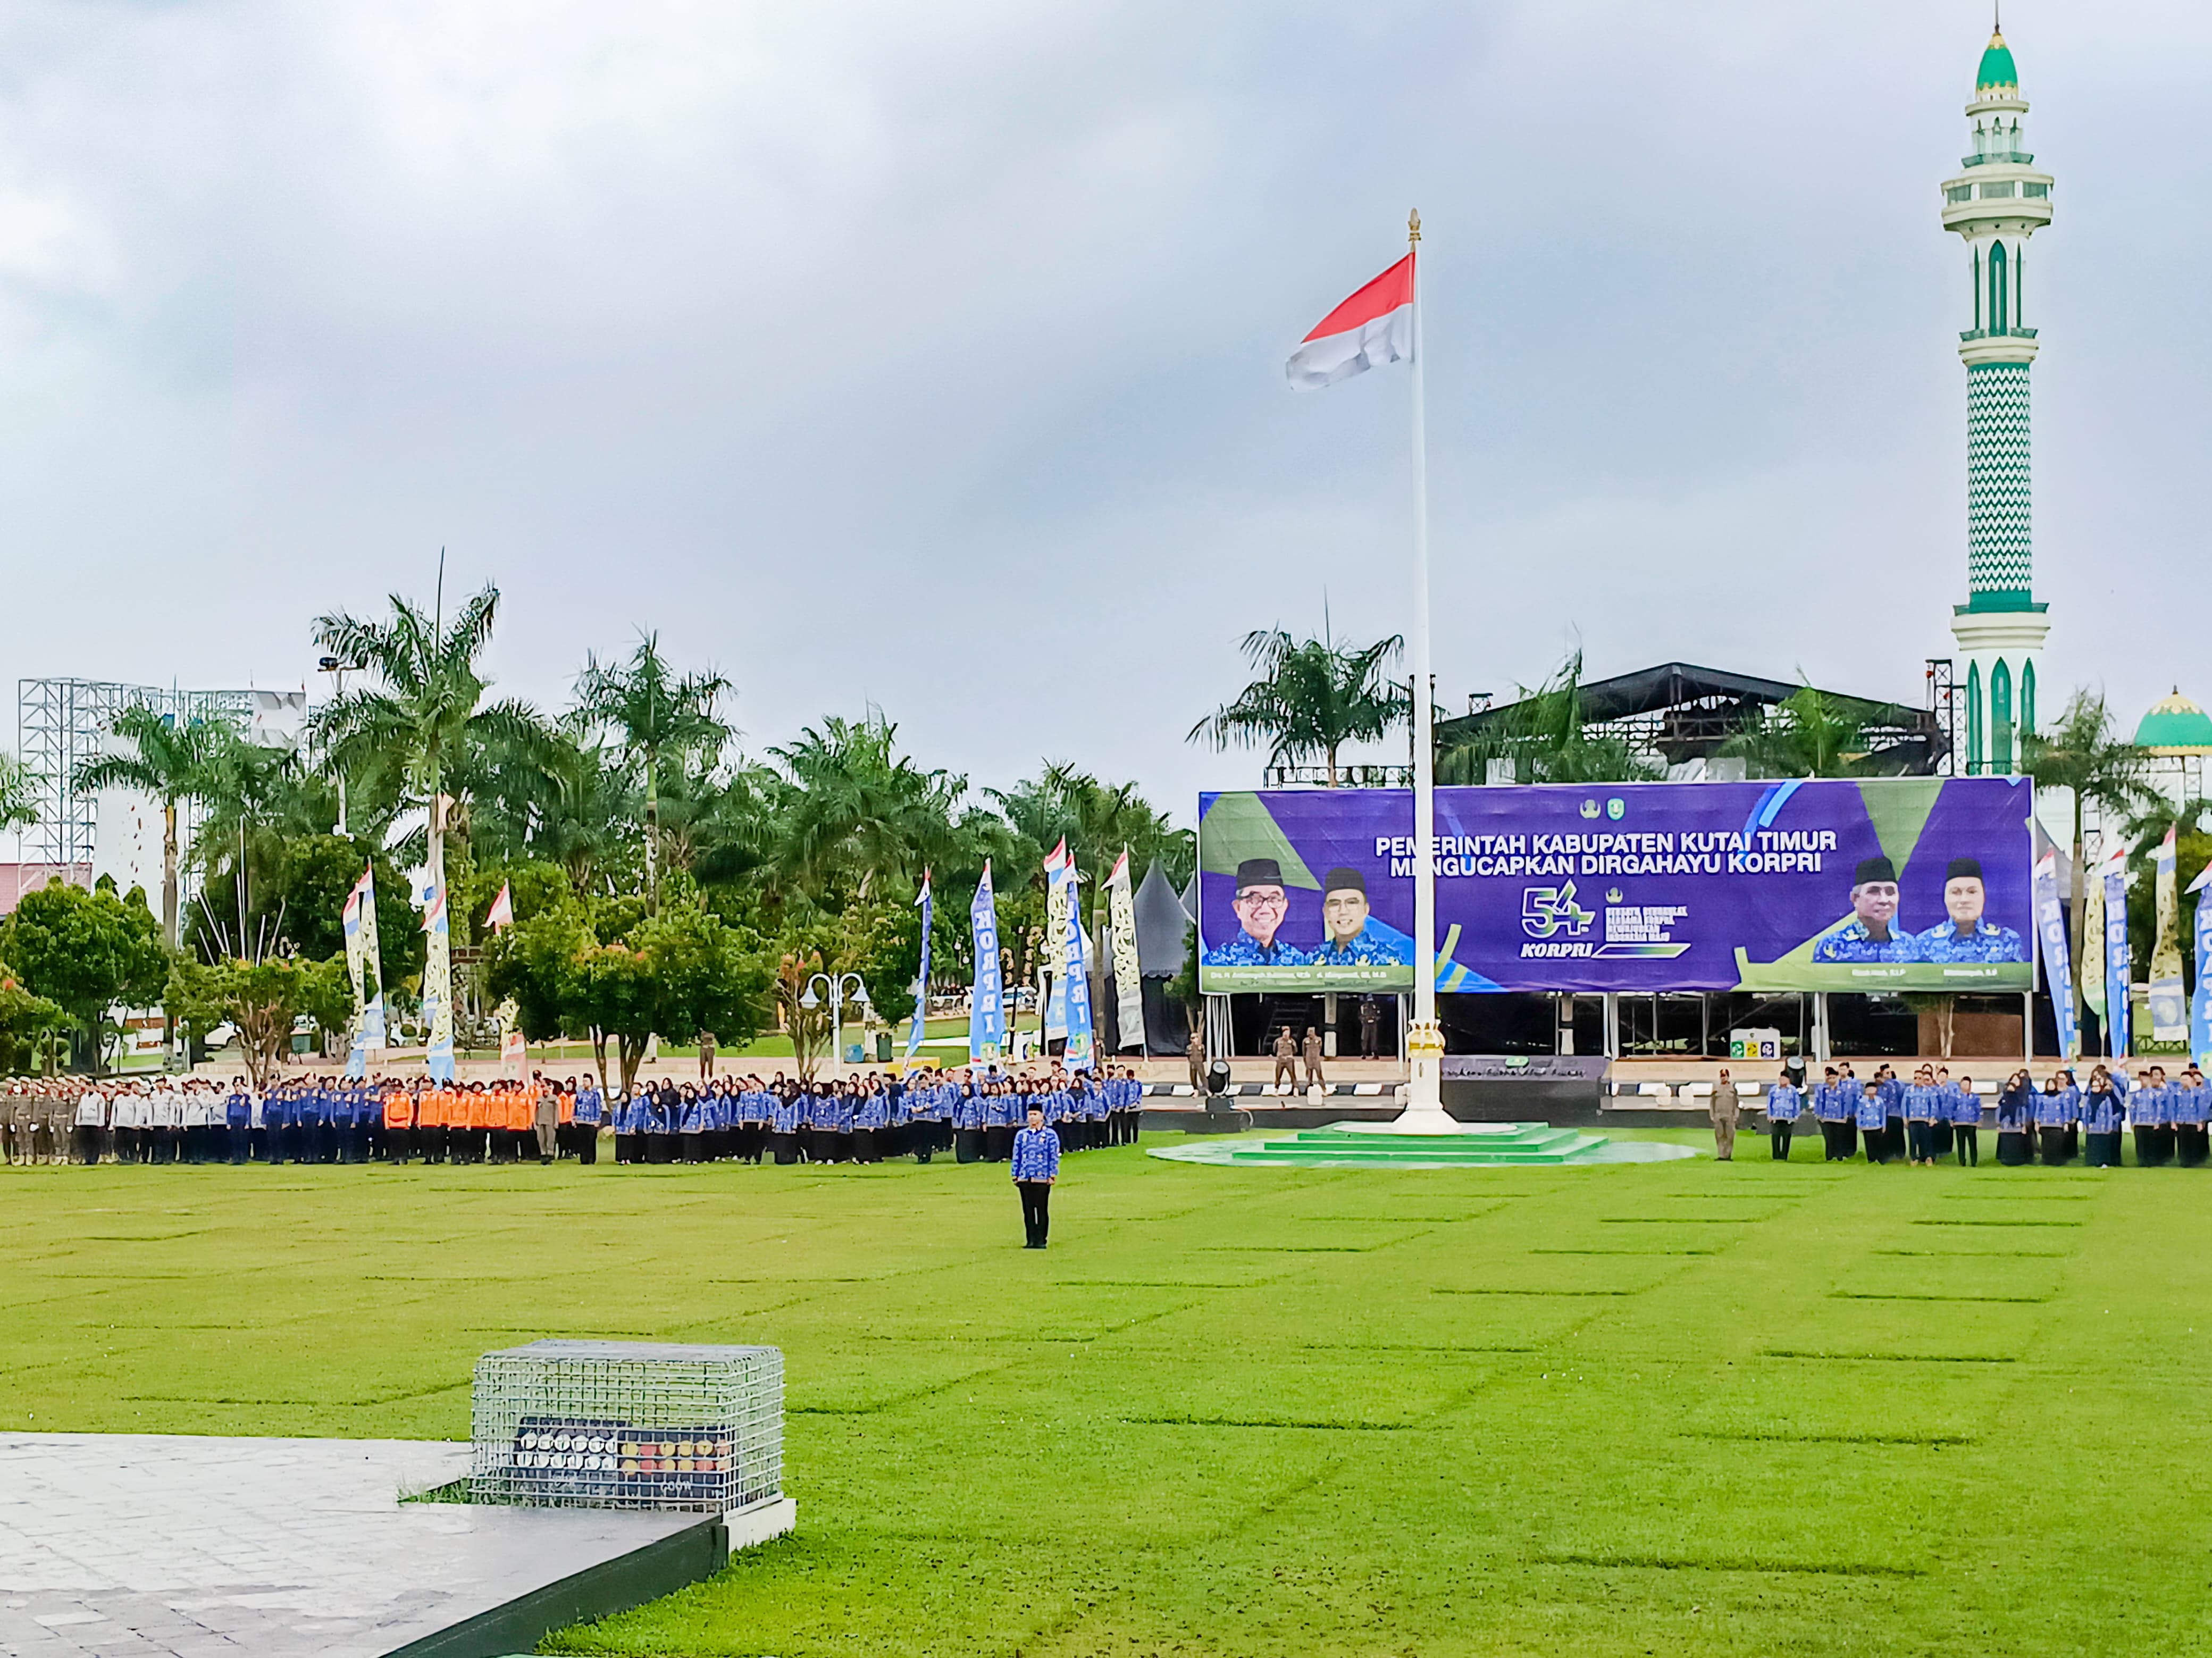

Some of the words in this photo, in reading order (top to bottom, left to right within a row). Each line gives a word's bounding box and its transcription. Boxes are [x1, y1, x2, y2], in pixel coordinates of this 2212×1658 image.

[1533, 833, 1673, 855] KABUPATEN
[1681, 832, 1751, 852] KUTAI
[1757, 831, 1837, 851] TIMUR
[1581, 853, 1721, 875] DIRGAHAYU
[1728, 852, 1821, 873] KORPRI
[1521, 943, 1594, 957] KORPRI
